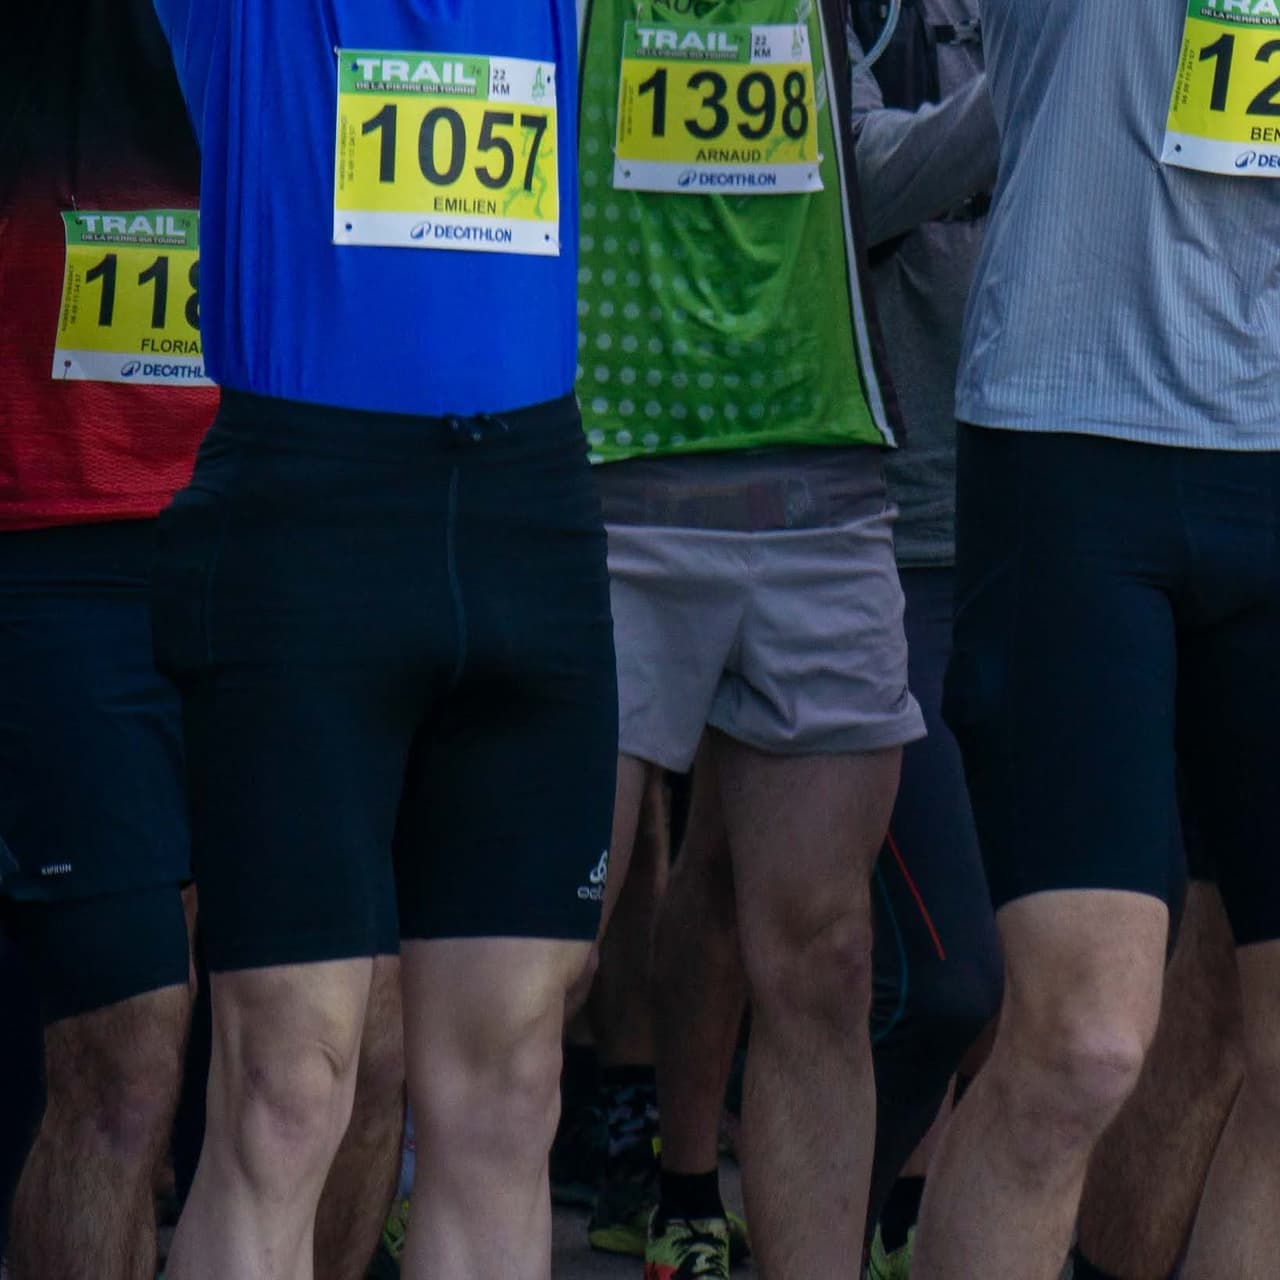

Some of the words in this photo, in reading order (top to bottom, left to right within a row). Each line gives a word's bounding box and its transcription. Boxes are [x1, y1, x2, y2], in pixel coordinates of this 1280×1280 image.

[636, 28, 738, 51] TRAIL
[355, 58, 477, 85] TRAIL
[493, 69, 506, 80] 22
[492, 84, 510, 95] KM
[638, 68, 809, 140] 1398
[361, 104, 548, 192] 1057
[695, 148, 762, 163] ARNAUD
[699, 172, 776, 187] DECATHLON
[433, 197, 497, 214] EMILIEN
[79, 215, 186, 237] TRAIL
[434, 224, 512, 242] DECATHLON
[141, 338, 202, 354] FLORIA
[143, 363, 206, 379] DECATHL
